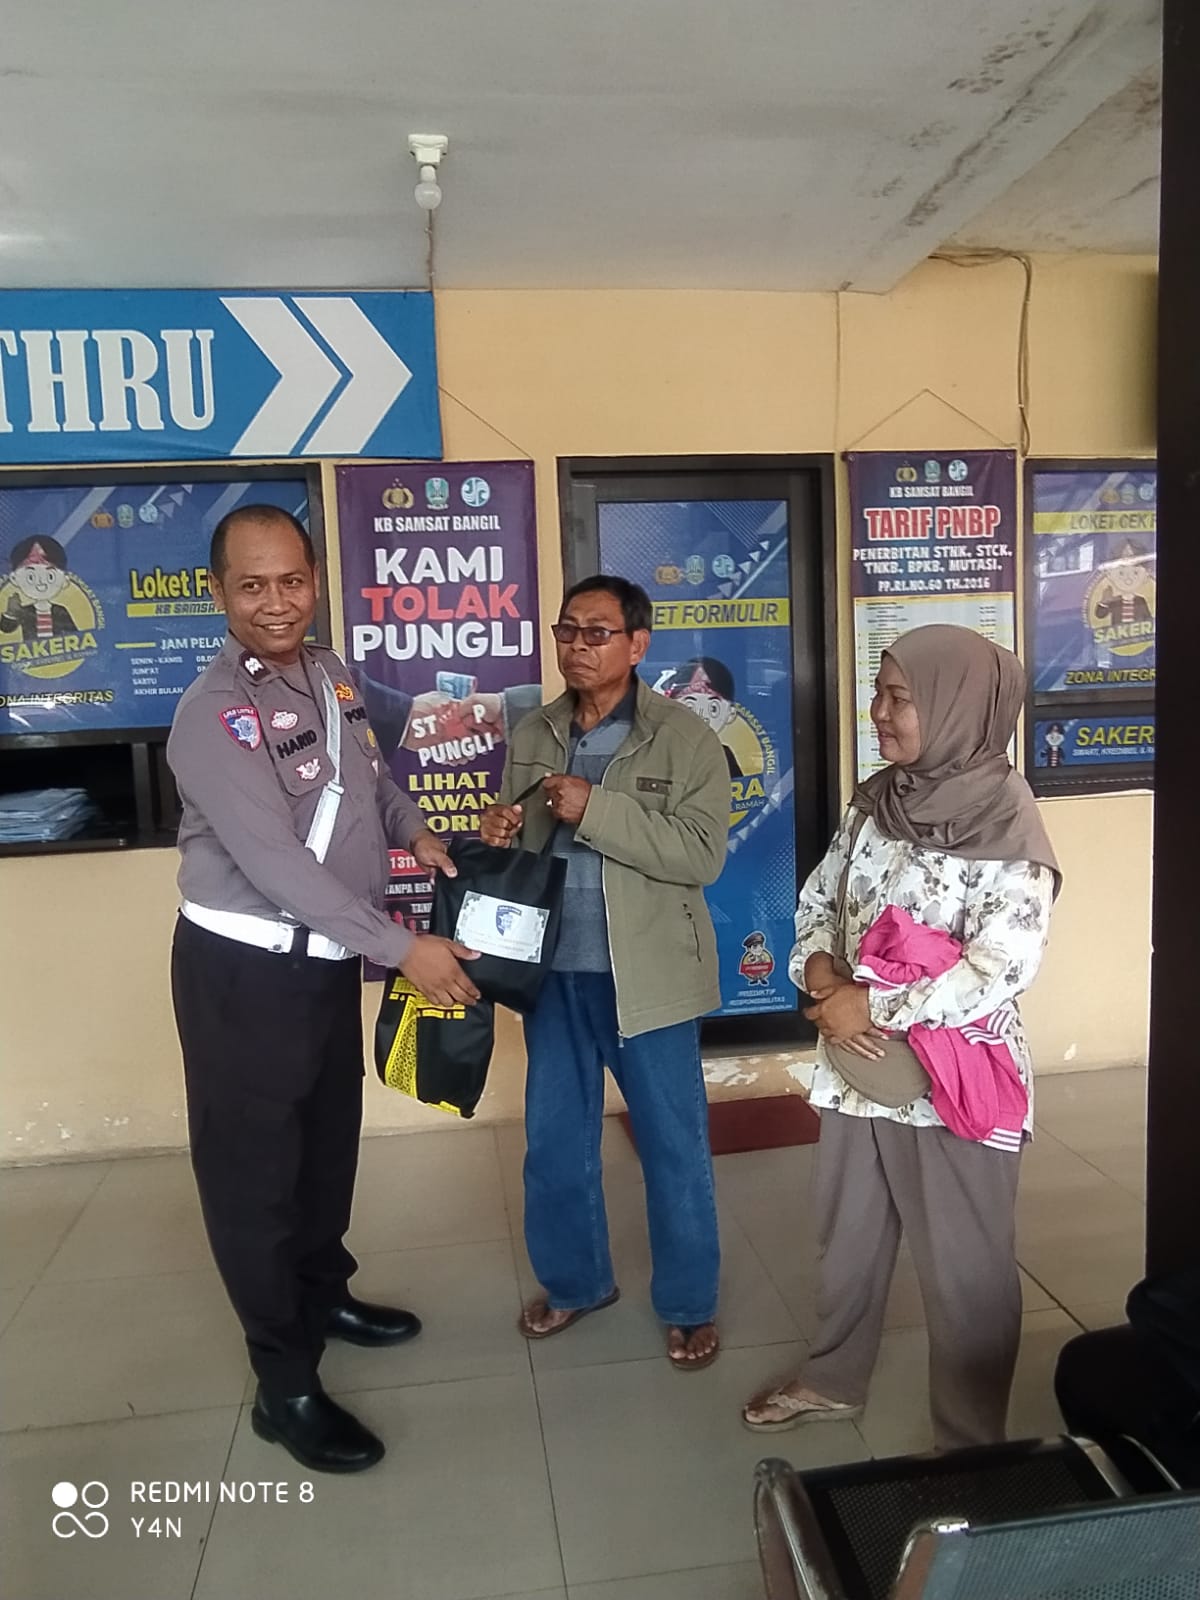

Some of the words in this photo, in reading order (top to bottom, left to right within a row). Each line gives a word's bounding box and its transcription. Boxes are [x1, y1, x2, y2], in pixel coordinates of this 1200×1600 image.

[904, 486, 940, 498] SAMSAT
[374, 517, 393, 532] KB
[395, 516, 450, 532] SAMSAT
[453, 515, 500, 531] BANGIL
[864, 506, 933, 541] TARIF
[935, 505, 1001, 539] PNBP
[1070, 514, 1117, 530] LOKET
[1119, 513, 1147, 528] CEK
[853, 547, 930, 561] PENERBITAN
[375, 546, 504, 584] KAMI
[130, 567, 191, 599] Loket
[174, 602, 219, 614] SAMSA
[361, 584, 521, 622] TOLAK
[654, 606, 677, 625] ET
[681, 603, 778, 624] FORMULIR
[0, 632, 97, 662] SAKERA
[160, 639, 188, 650] JAM
[352, 621, 533, 662] PUNGLI
[1066, 671, 1105, 685] ZONA
[29, 690, 113, 704] INTEGRITAS
[1076, 726, 1154, 746] SAKER
[418, 732, 494, 767] PUNGLI
[409, 771, 491, 792] LIHAT
[735, 800, 765, 811] RAMAH
